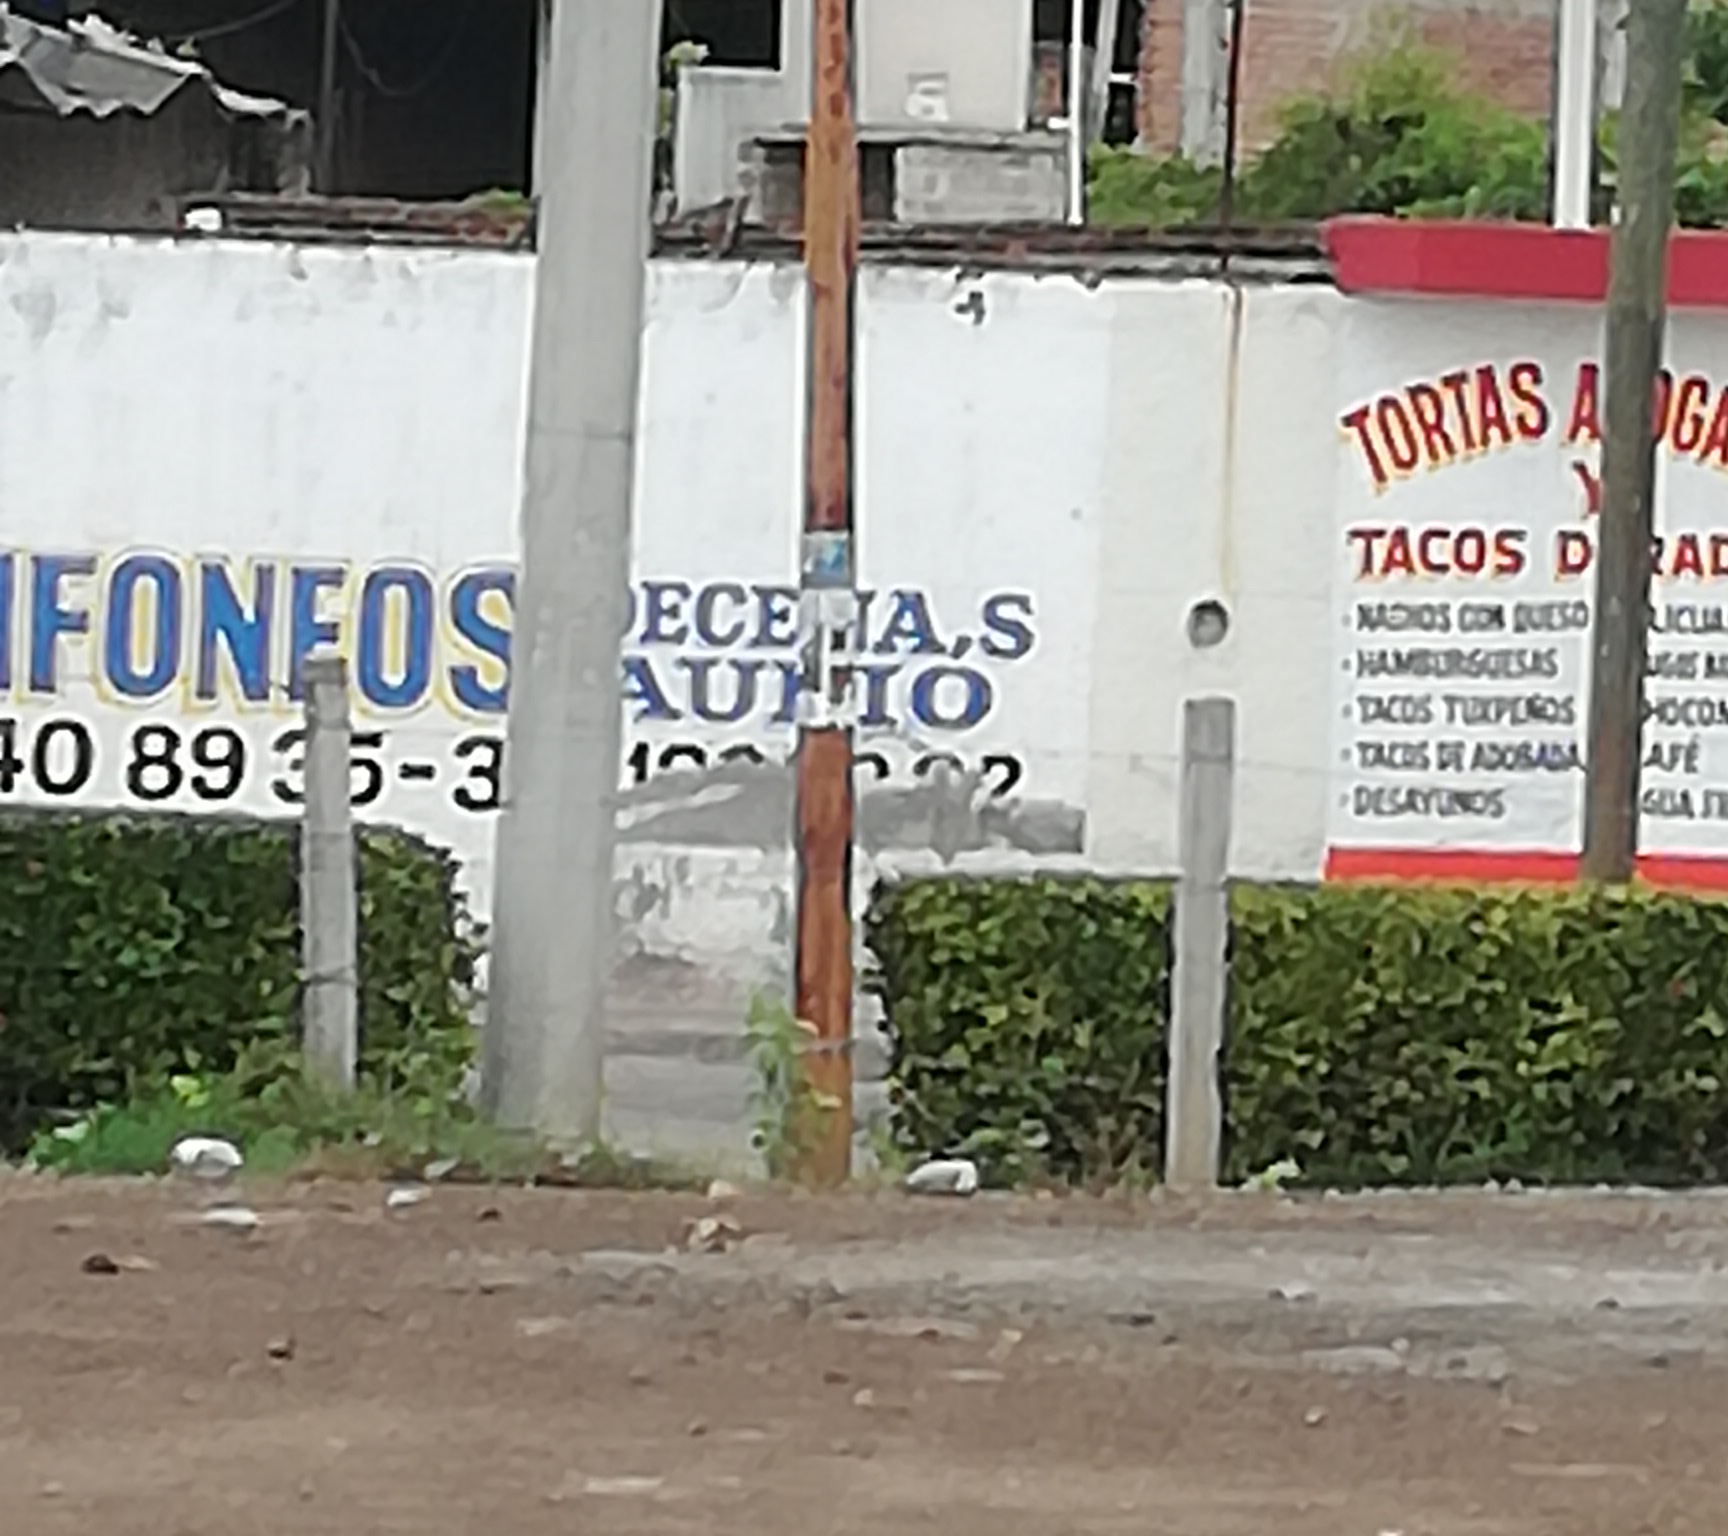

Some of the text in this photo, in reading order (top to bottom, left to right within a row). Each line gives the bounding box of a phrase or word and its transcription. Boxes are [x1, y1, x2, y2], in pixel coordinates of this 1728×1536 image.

[1341, 362, 1549, 490] TORTAS
[1348, 528, 1527, 580] TACOS
[622, 580, 1035, 661] ECEA,S
[1357, 600, 1589, 633] NACHOS CON QUESO
[1357, 648, 1559, 679] HAMBURGUESAS
[1356, 694, 1433, 725] TACOS
[126, 725, 245, 801] 89
[1356, 741, 1430, 771] TACOS
[1643, 733, 1699, 774] AFÉ
[1354, 785, 1506, 818] DESAYUNOS
[1641, 788, 1695, 819] GUA
